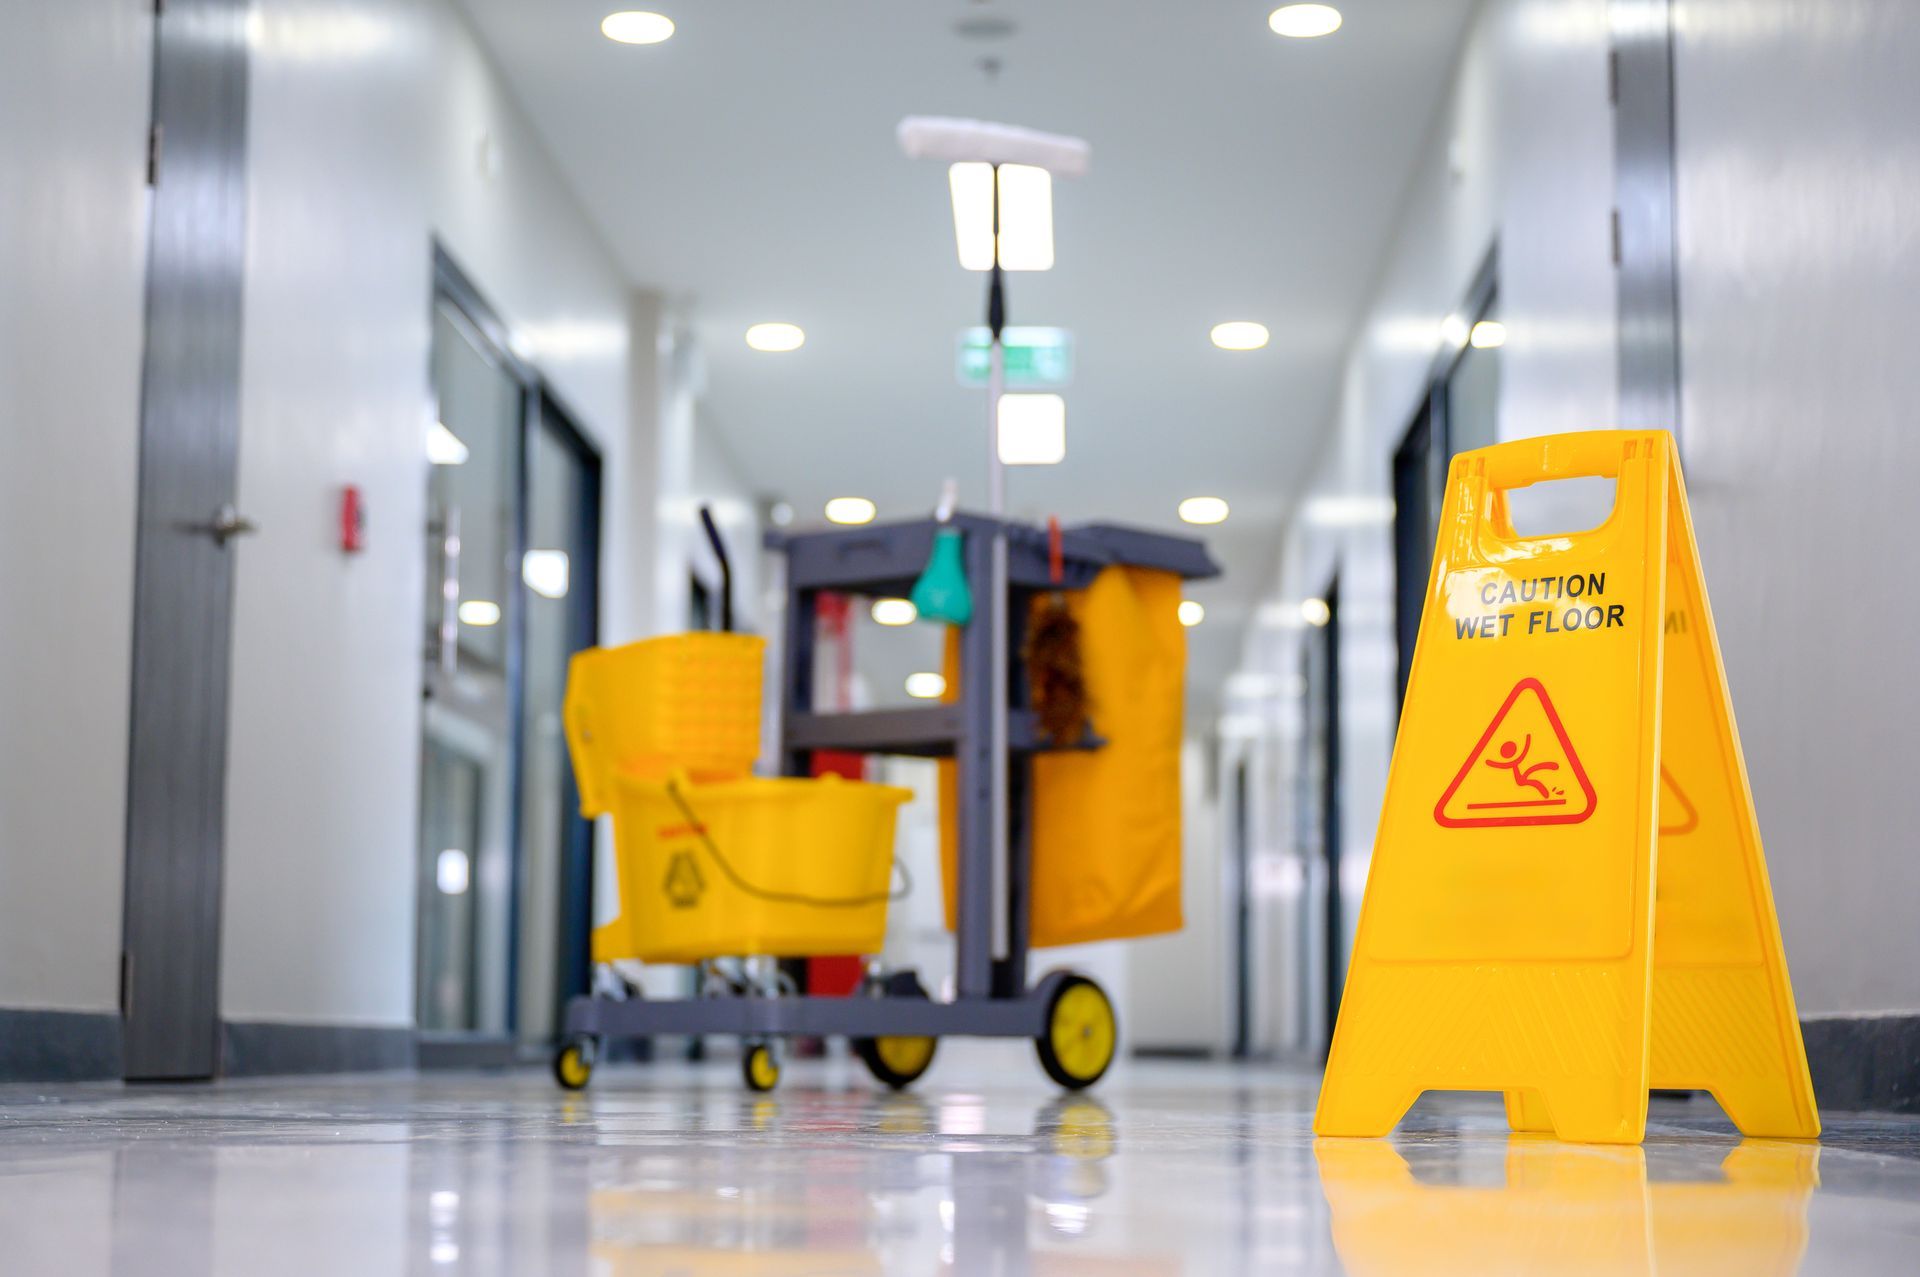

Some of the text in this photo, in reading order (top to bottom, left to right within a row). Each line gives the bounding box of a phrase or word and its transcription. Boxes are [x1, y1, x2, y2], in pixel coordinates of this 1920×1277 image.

[1481, 573, 1605, 605] CAUTION
[1455, 604, 1624, 640] WET FLOOR
